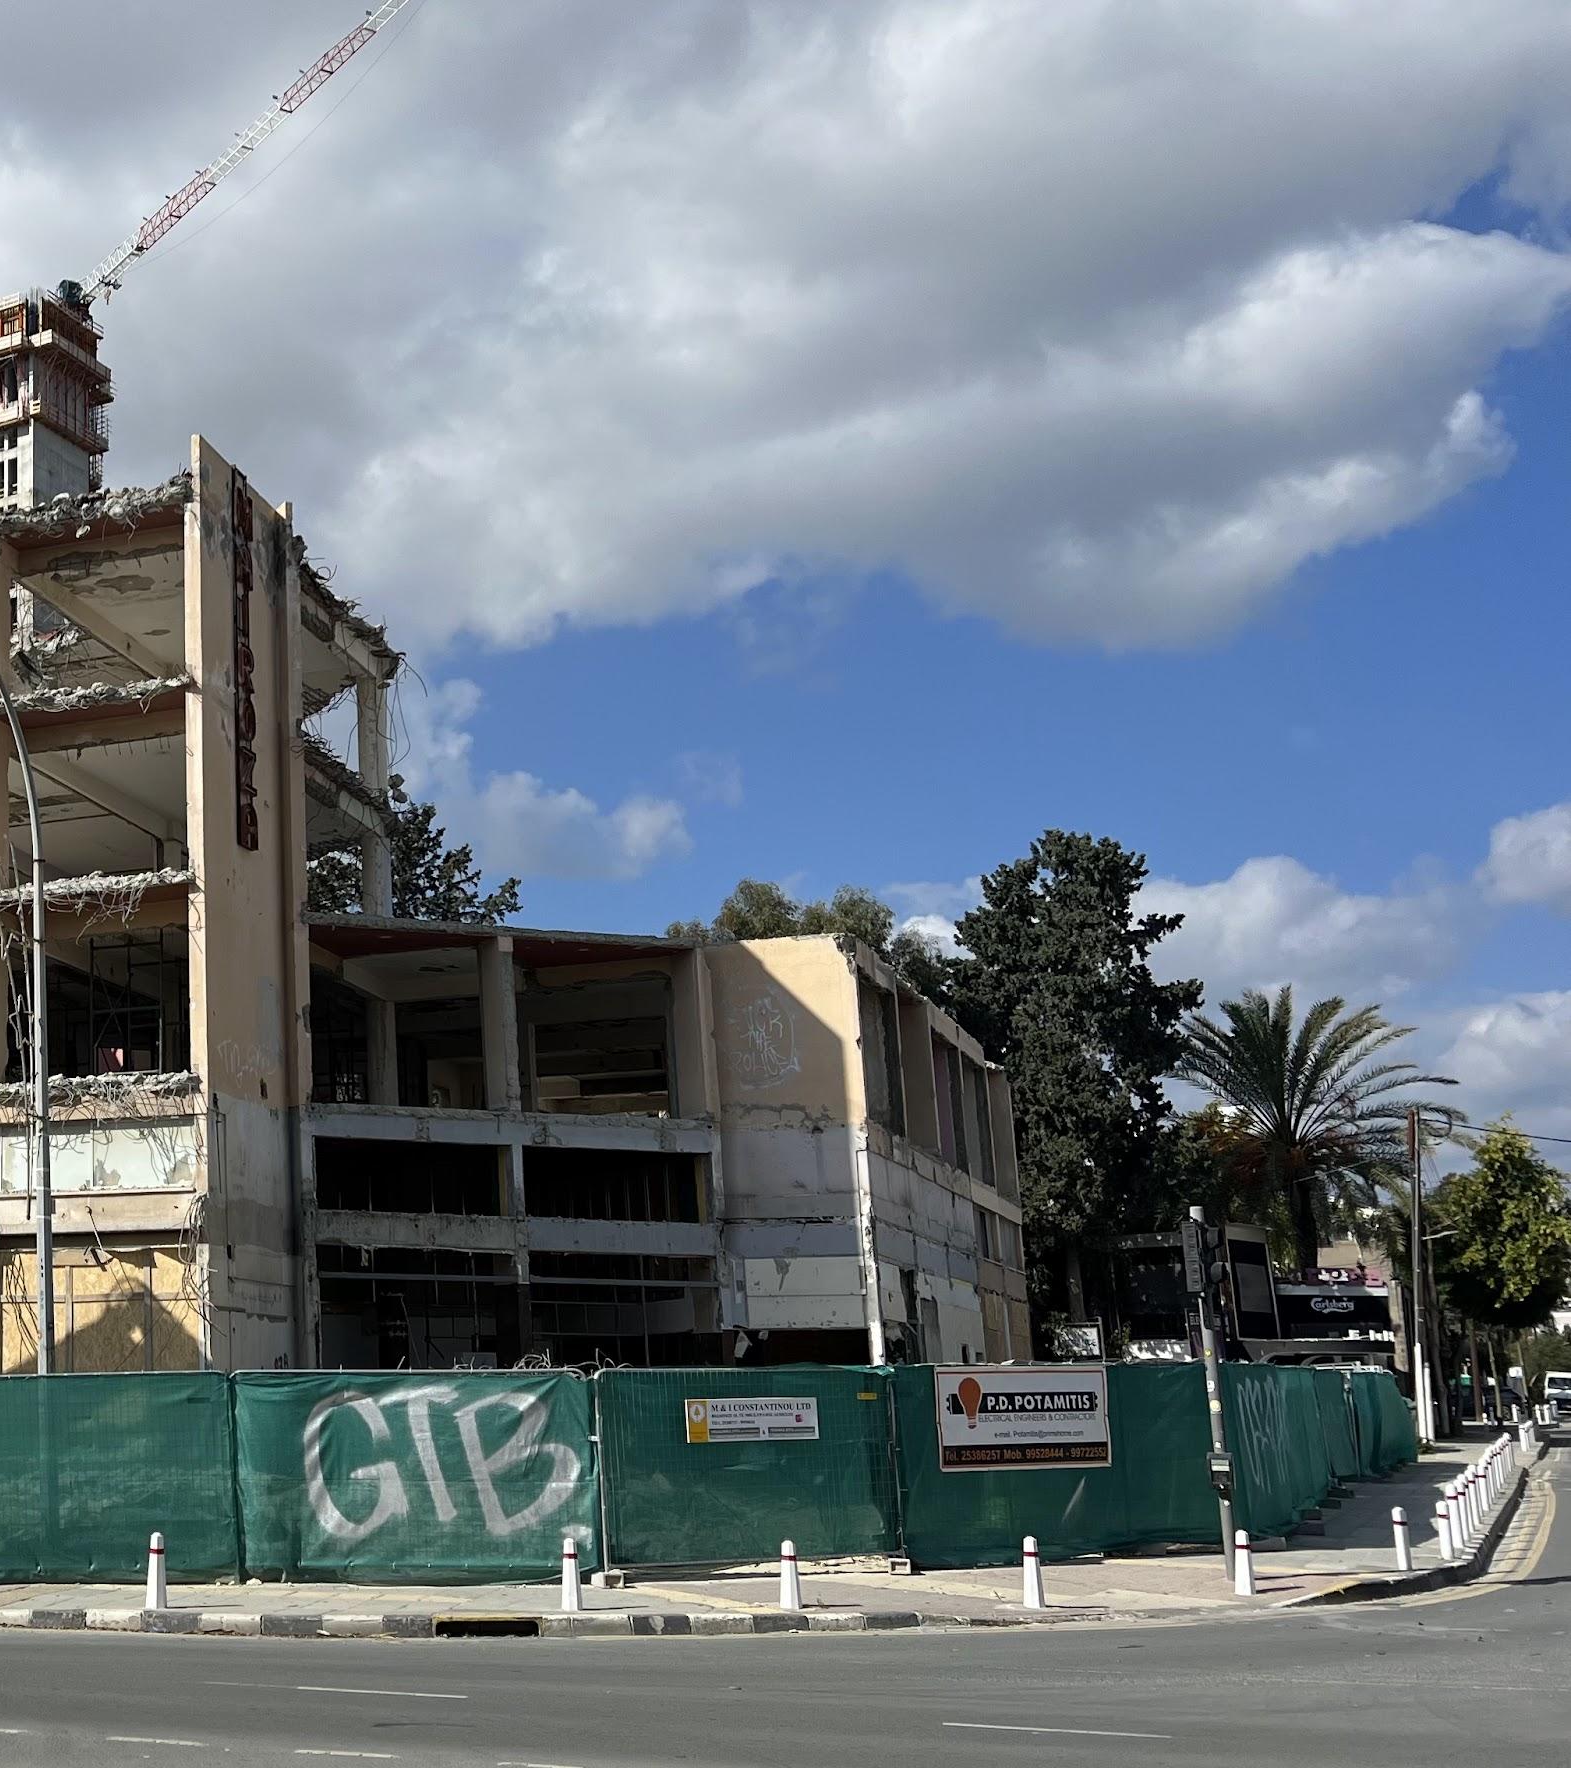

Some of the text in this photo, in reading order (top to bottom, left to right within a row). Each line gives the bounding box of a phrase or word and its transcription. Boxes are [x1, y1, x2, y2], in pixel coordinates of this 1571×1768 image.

[1310, 1297, 1355, 1314] Carlsberg
[732, 1402, 794, 1411] CONSTANTINOU
[796, 1402, 811, 1410] LTD
[987, 1394, 1091, 1411] P.D. POTAMITIS
[978, 1413, 1013, 1423] ELECTRICAL
[1013, 1413, 1048, 1422] ENGINEERS
[1053, 1412, 1096, 1421] CONTRACTORS
[303, 1386, 581, 1541] GTB
